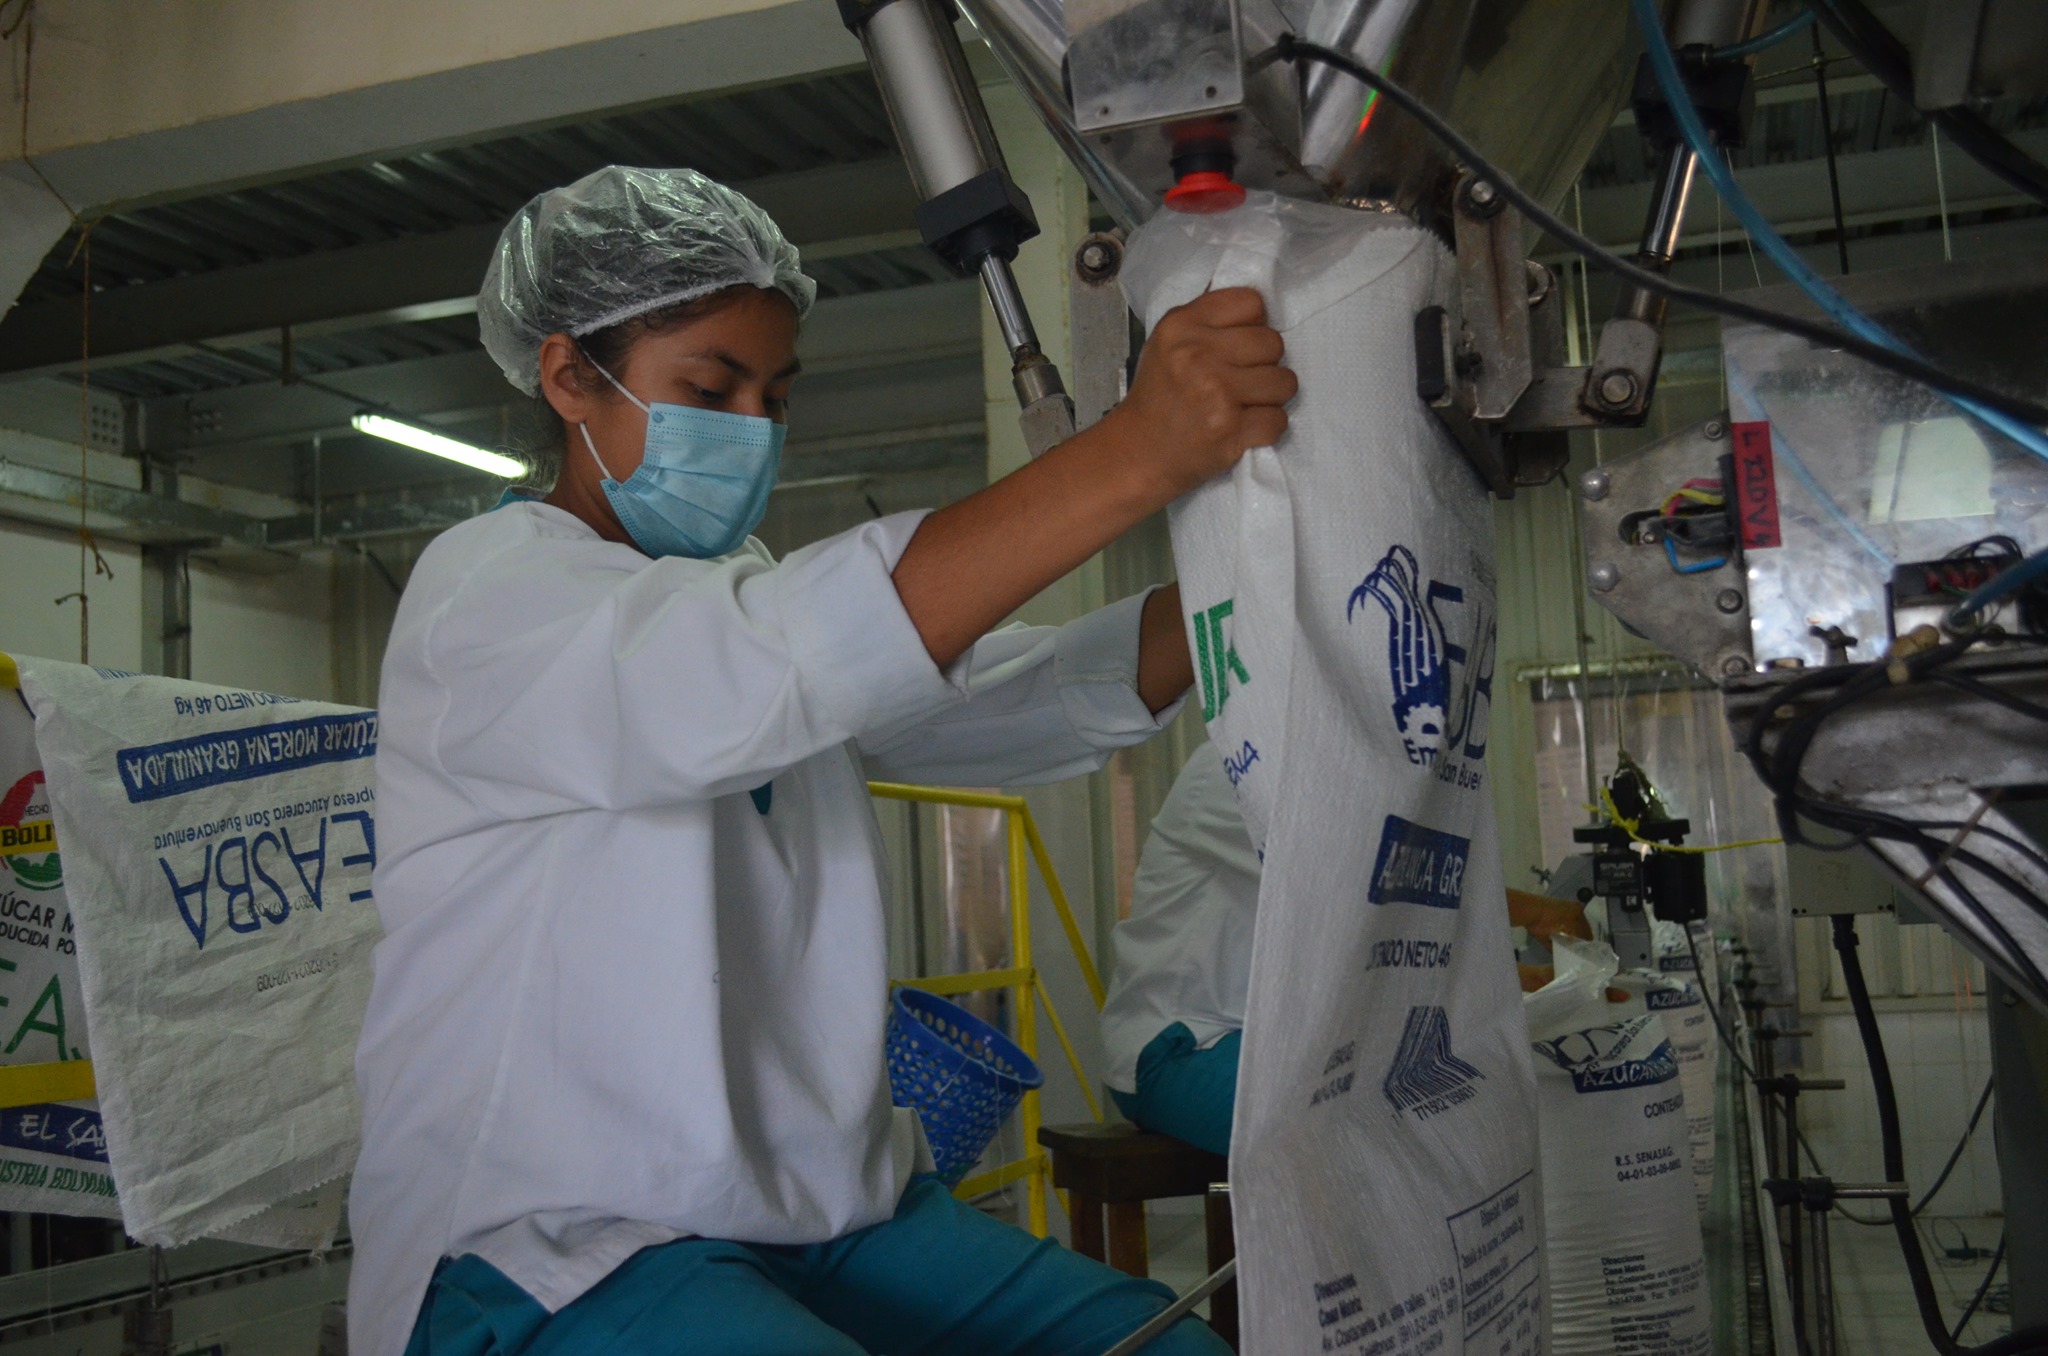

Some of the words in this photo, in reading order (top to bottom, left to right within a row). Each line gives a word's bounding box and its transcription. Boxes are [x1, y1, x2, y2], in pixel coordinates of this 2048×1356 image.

[174, 696, 194, 717] kg
[195, 696, 212, 715] 46
[214, 692, 254, 712] NETO
[246, 725, 319, 765] MORENA
[125, 738, 240, 789] GRANULADA
[25, 803, 50, 816] HECHO
[245, 808, 271, 828] San
[273, 797, 331, 822] Azucarera
[2, 823, 56, 847] BOLI
[153, 817, 242, 851] Buenaventura
[158, 810, 376, 951] EASBA
[0, 890, 55, 929] ÚCAR
[56, 937, 77, 956] PO
[1404, 940, 1439, 968] NETO
[20, 1112, 56, 1141] EL
[65, 1116, 108, 1154] SA
[1614, 1154, 1634, 1168] R.S.
[48, 1166, 119, 1198] BOLIVIAN
